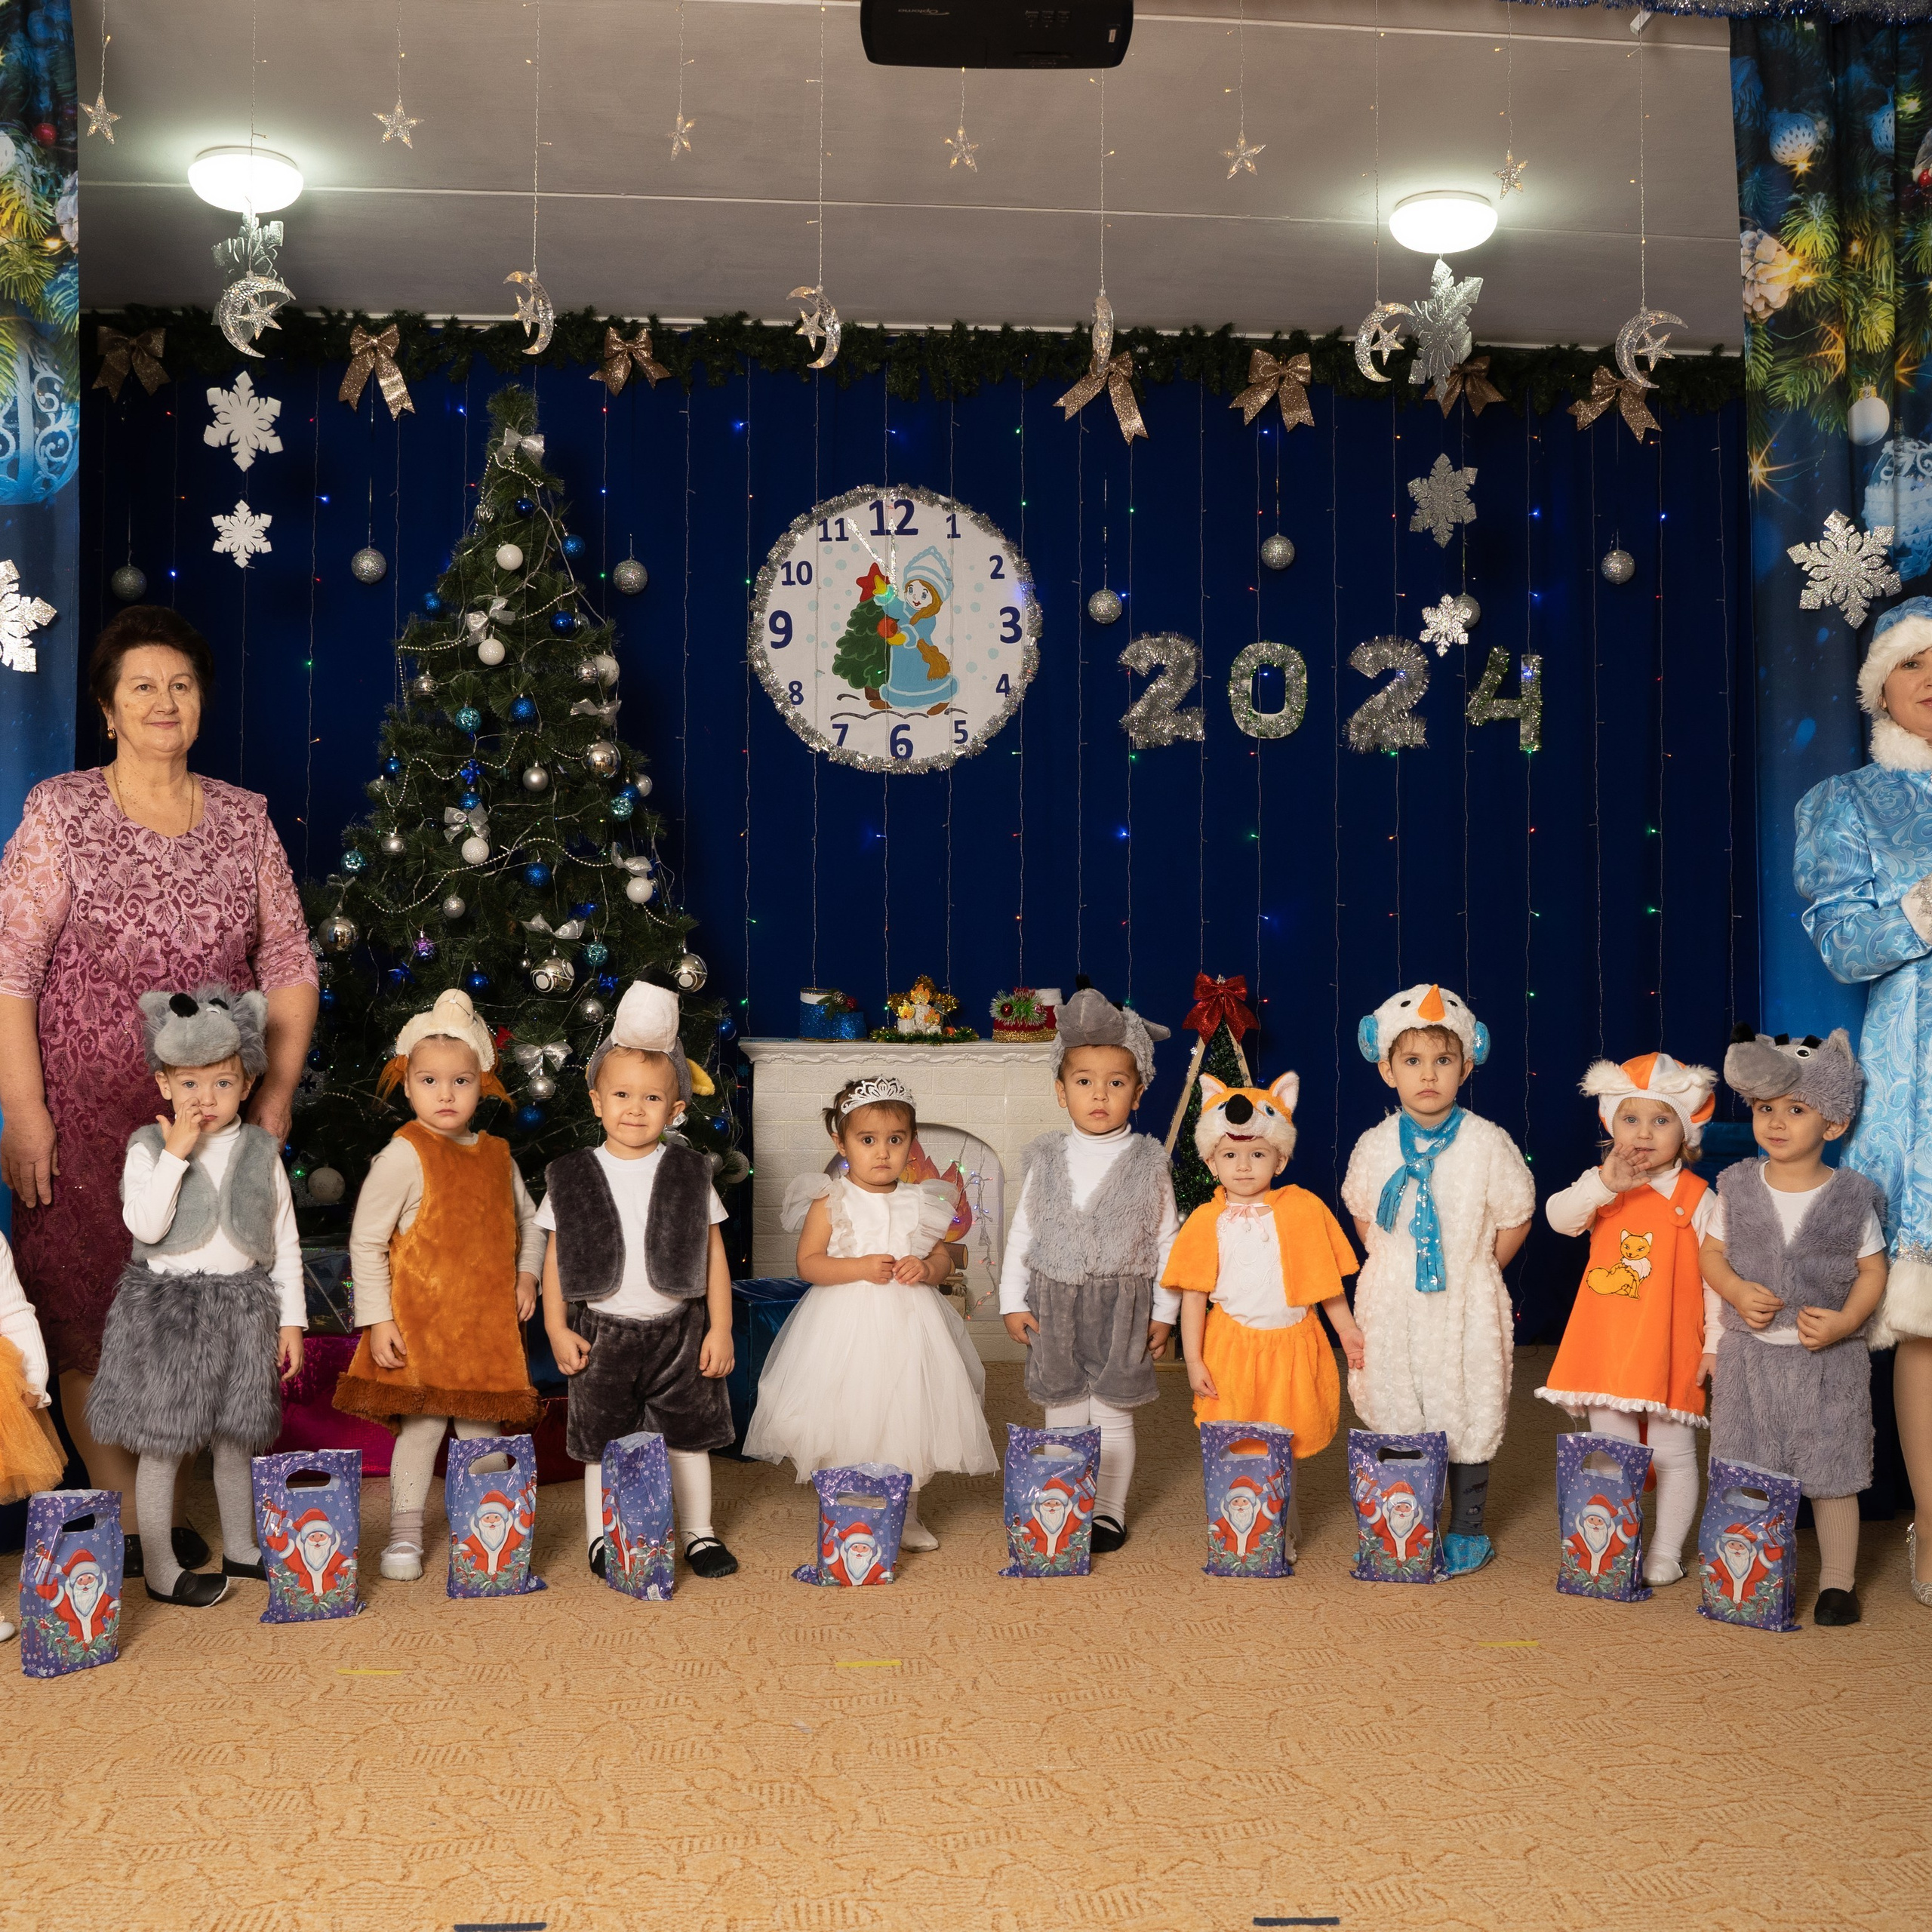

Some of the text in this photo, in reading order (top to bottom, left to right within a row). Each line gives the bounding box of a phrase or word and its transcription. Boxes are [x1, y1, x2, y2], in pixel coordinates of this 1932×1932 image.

[818, 518, 850, 542] 11
[869, 499, 918, 536] 12
[946, 514, 961, 539] 1
[780, 561, 813, 586] 10
[989, 555, 1005, 580] 2
[768, 610, 792, 649] 9
[999, 606, 1022, 644] 3
[788, 681, 804, 705] 8
[996, 673, 1011, 697] 4
[1118, 631, 1543, 753] 2024
[832, 723, 848, 746] 7
[889, 724, 913, 759] 6
[954, 720, 968, 744] 5
